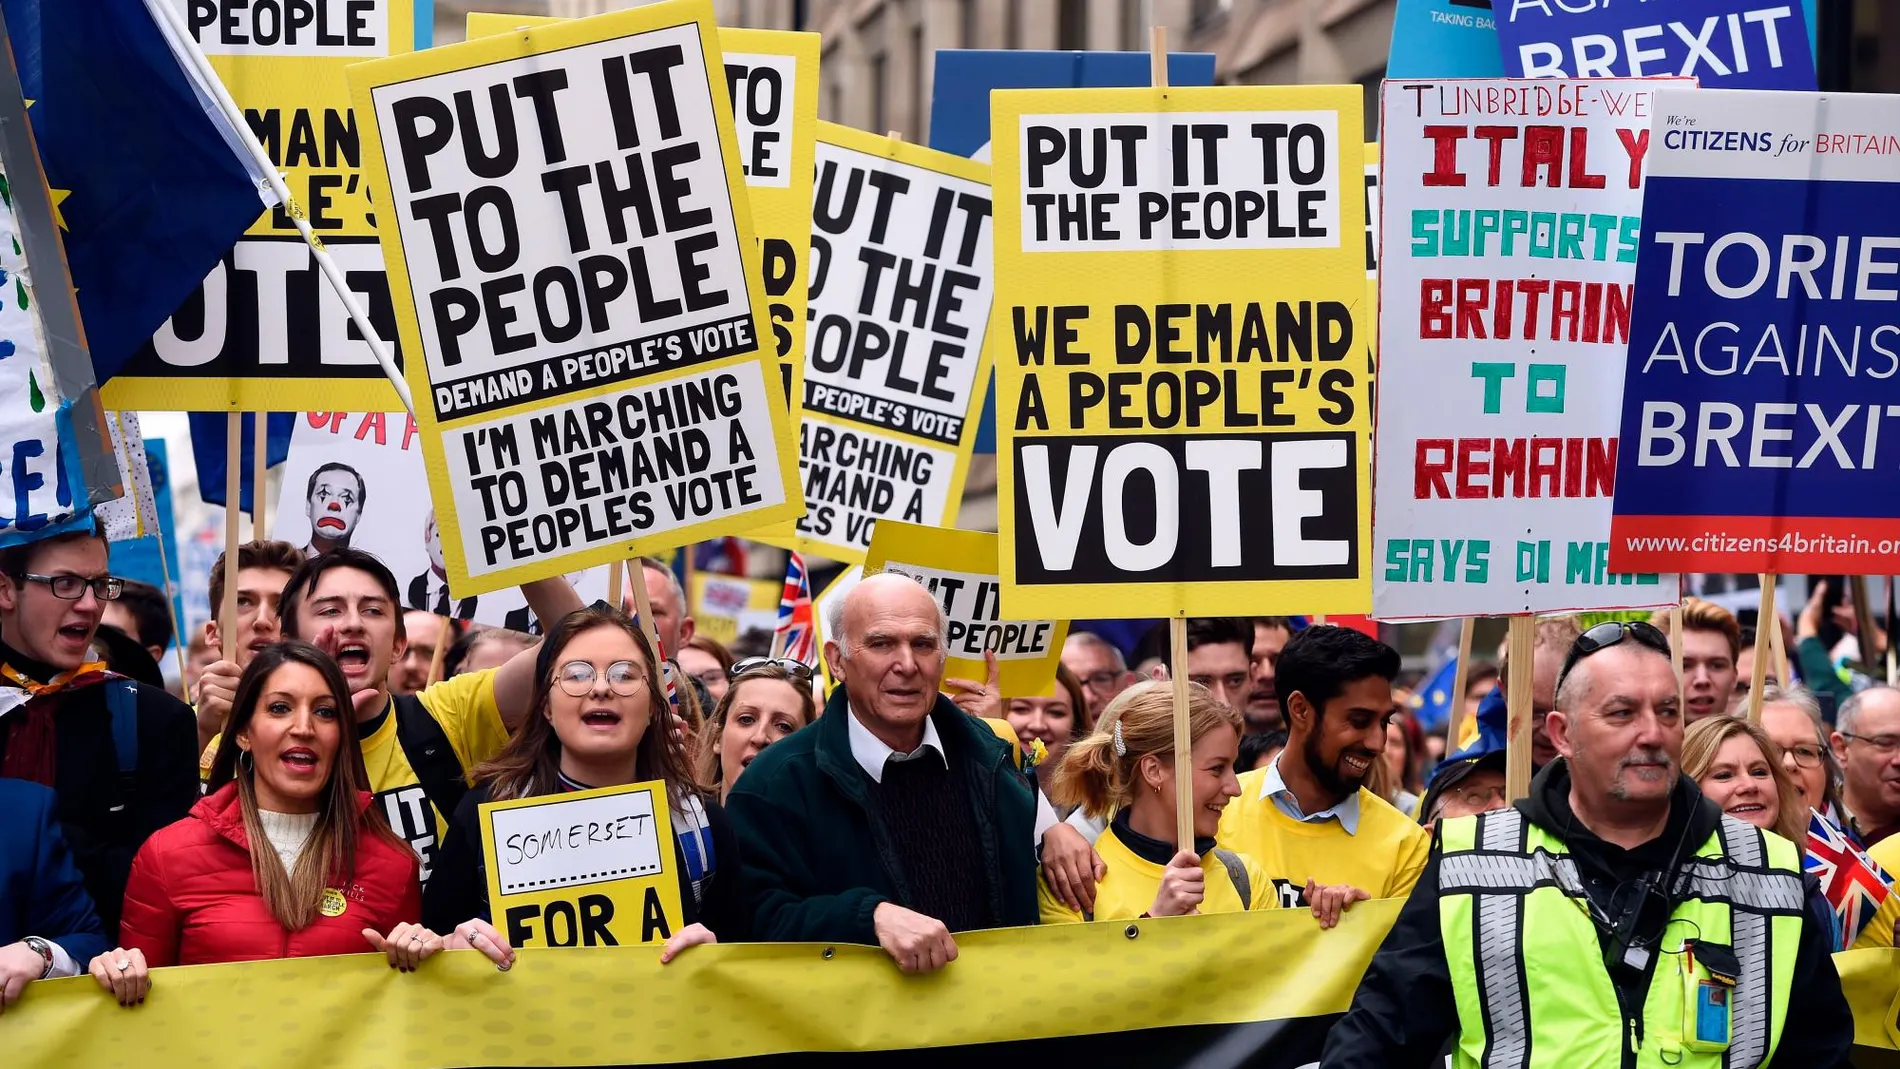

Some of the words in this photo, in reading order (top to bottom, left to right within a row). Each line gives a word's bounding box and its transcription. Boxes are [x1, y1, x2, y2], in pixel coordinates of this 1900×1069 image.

[188, 0, 375, 46] PEOPLE
[1430, 10, 1473, 27] TAKING
[1519, 6, 1791, 78] BREXIT
[392, 68, 568, 193] PUT
[602, 45, 684, 150] IT
[1403, 84, 1653, 117] TUNBRIDGE-WE
[1666, 115, 1697, 126] We're
[245, 108, 360, 167] MAN
[1027, 124, 1147, 188] PUT
[1171, 124, 1228, 187] IT
[1251, 123, 1326, 186] TO
[1421, 125, 1649, 189] ITALY
[1664, 130, 1773, 152] CITIZENS
[1774, 134, 1810, 158] for
[1815, 133, 1900, 155] BRITAIN
[410, 185, 520, 282] TO
[541, 141, 712, 254] THE
[813, 160, 911, 245] UT
[923, 187, 993, 267] IT
[1027, 193, 1120, 241] THE
[1139, 190, 1327, 240] PEOPLE
[1411, 209, 1640, 262] SUPPORTS
[808, 234, 832, 301] O
[858, 246, 981, 340] THE
[1654, 231, 1900, 301] TORIE
[153, 240, 395, 366] OTE
[430, 231, 729, 367] PEOPLE
[1420, 278, 1633, 344] BRITAIN
[807, 308, 965, 403] OPLE
[1012, 306, 1090, 366] WE
[1115, 301, 1354, 365] DEMAND
[1641, 321, 1900, 379] AGAINS
[435, 369, 533, 414] DEMAND
[542, 363, 558, 390] A
[562, 336, 683, 389] PEOPLE'S
[688, 319, 752, 356] VOTE
[1471, 361, 1566, 414] TO
[463, 423, 520, 476] I'M
[530, 373, 742, 460] MARCHING
[811, 384, 907, 427] PEOPLE'S
[911, 409, 961, 440] VOTE
[1014, 373, 1049, 430] A
[1069, 368, 1355, 430] PEOPLE'S
[471, 470, 528, 522] TO
[540, 428, 711, 507] DEMAND
[729, 418, 755, 464] A
[799, 460, 894, 514] MAND
[903, 488, 923, 523] A
[1414, 438, 1618, 500] REMAIN
[481, 491, 654, 566] PEOPLES
[663, 465, 762, 521] VOTE
[847, 512, 876, 547] VO
[1021, 440, 1349, 572] VOTE
[1385, 539, 1490, 583] SAYS
[1516, 540, 1551, 584] DI
[1626, 531, 1900, 554] www.citizens4britain.or
[947, 621, 1049, 654] PEOPLE
[384, 787, 427, 839] IT
[506, 813, 651, 865] SOMERSET
[505, 894, 619, 948] FOR
[641, 886, 673, 943] A
